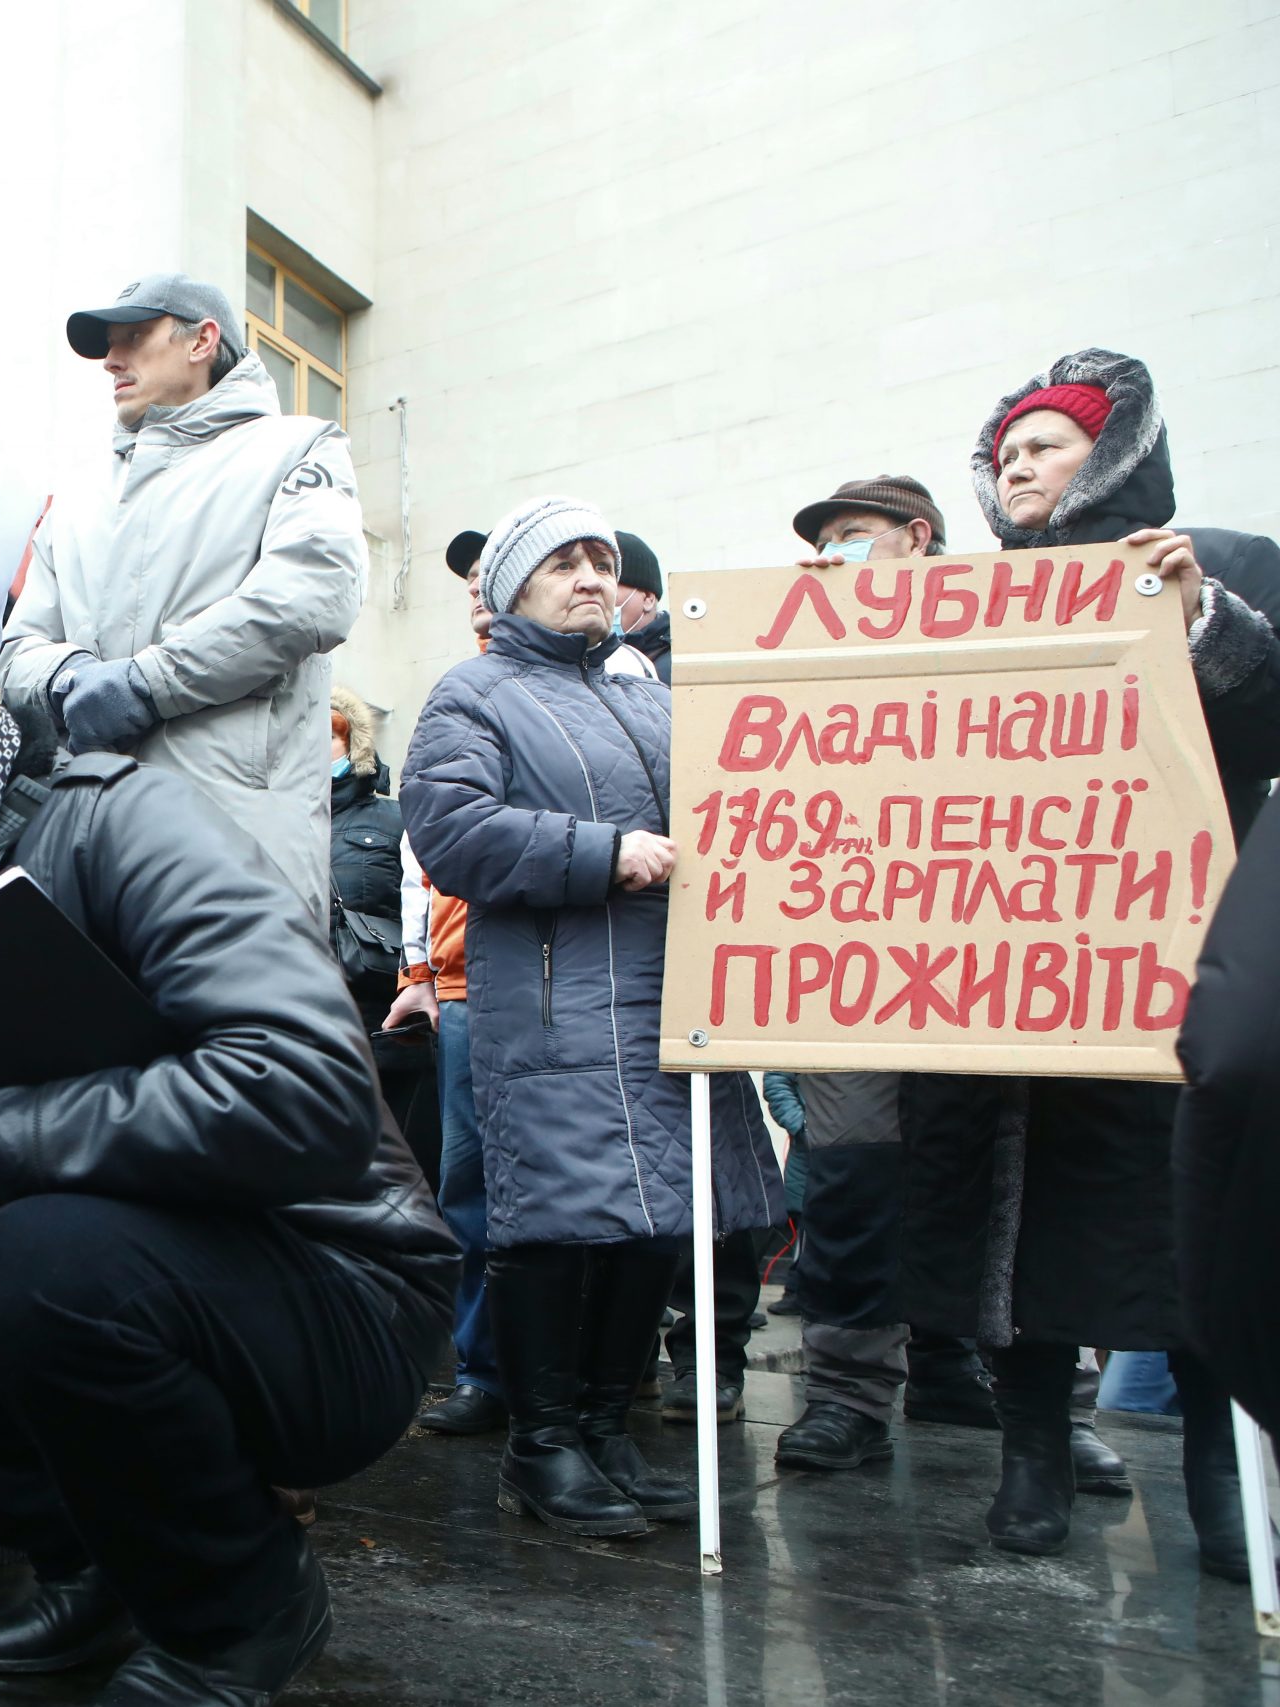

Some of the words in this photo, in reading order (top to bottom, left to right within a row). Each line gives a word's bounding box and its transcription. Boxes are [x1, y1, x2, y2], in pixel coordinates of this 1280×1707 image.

[756, 558, 1124, 650] ЛУБНИ
[718, 690, 937, 772] Владі
[692, 787, 843, 862] 1769
[878, 779, 1149, 853] ПЕНСІЇ
[710, 932, 1191, 1032] ПРОЖИВІТЬ
